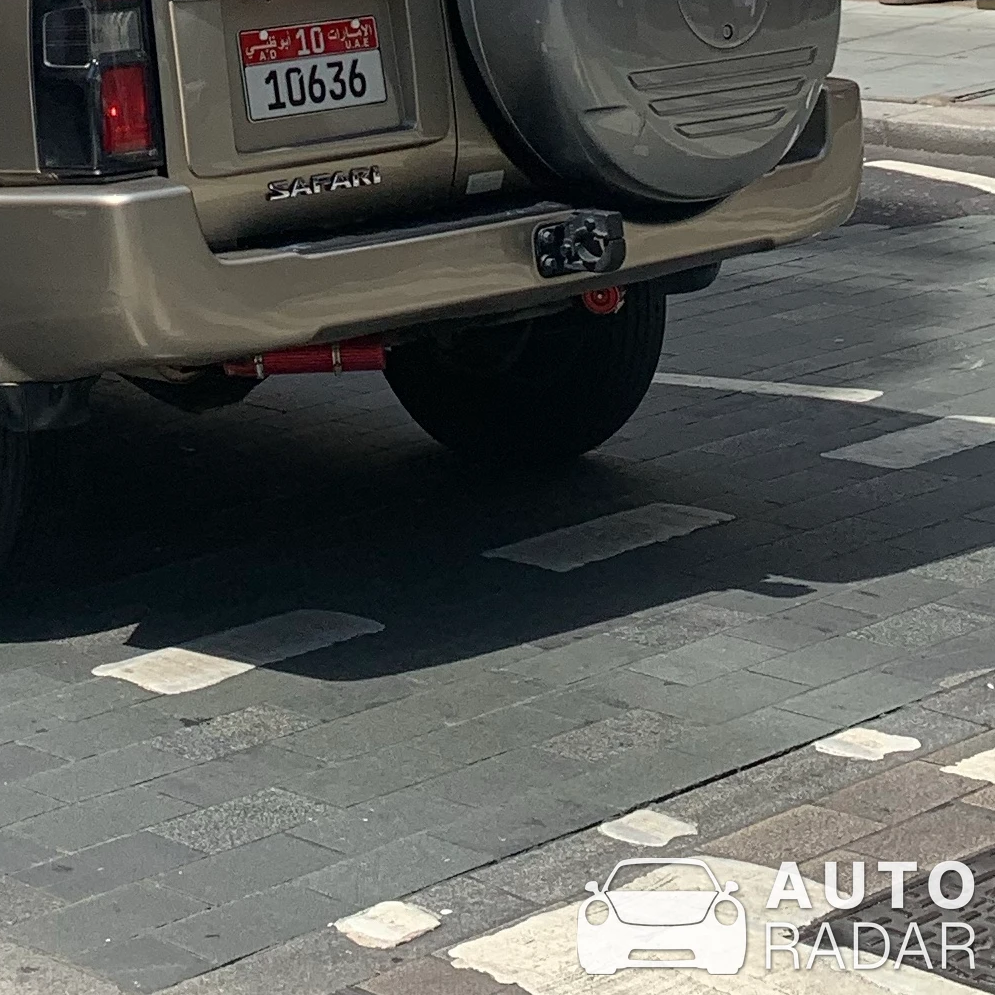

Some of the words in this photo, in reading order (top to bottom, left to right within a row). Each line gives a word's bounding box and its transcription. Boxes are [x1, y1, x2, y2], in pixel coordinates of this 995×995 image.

[296, 27, 325, 55] 10
[265, 58, 367, 111] 10636
[267, 165, 382, 201] SAFARI
